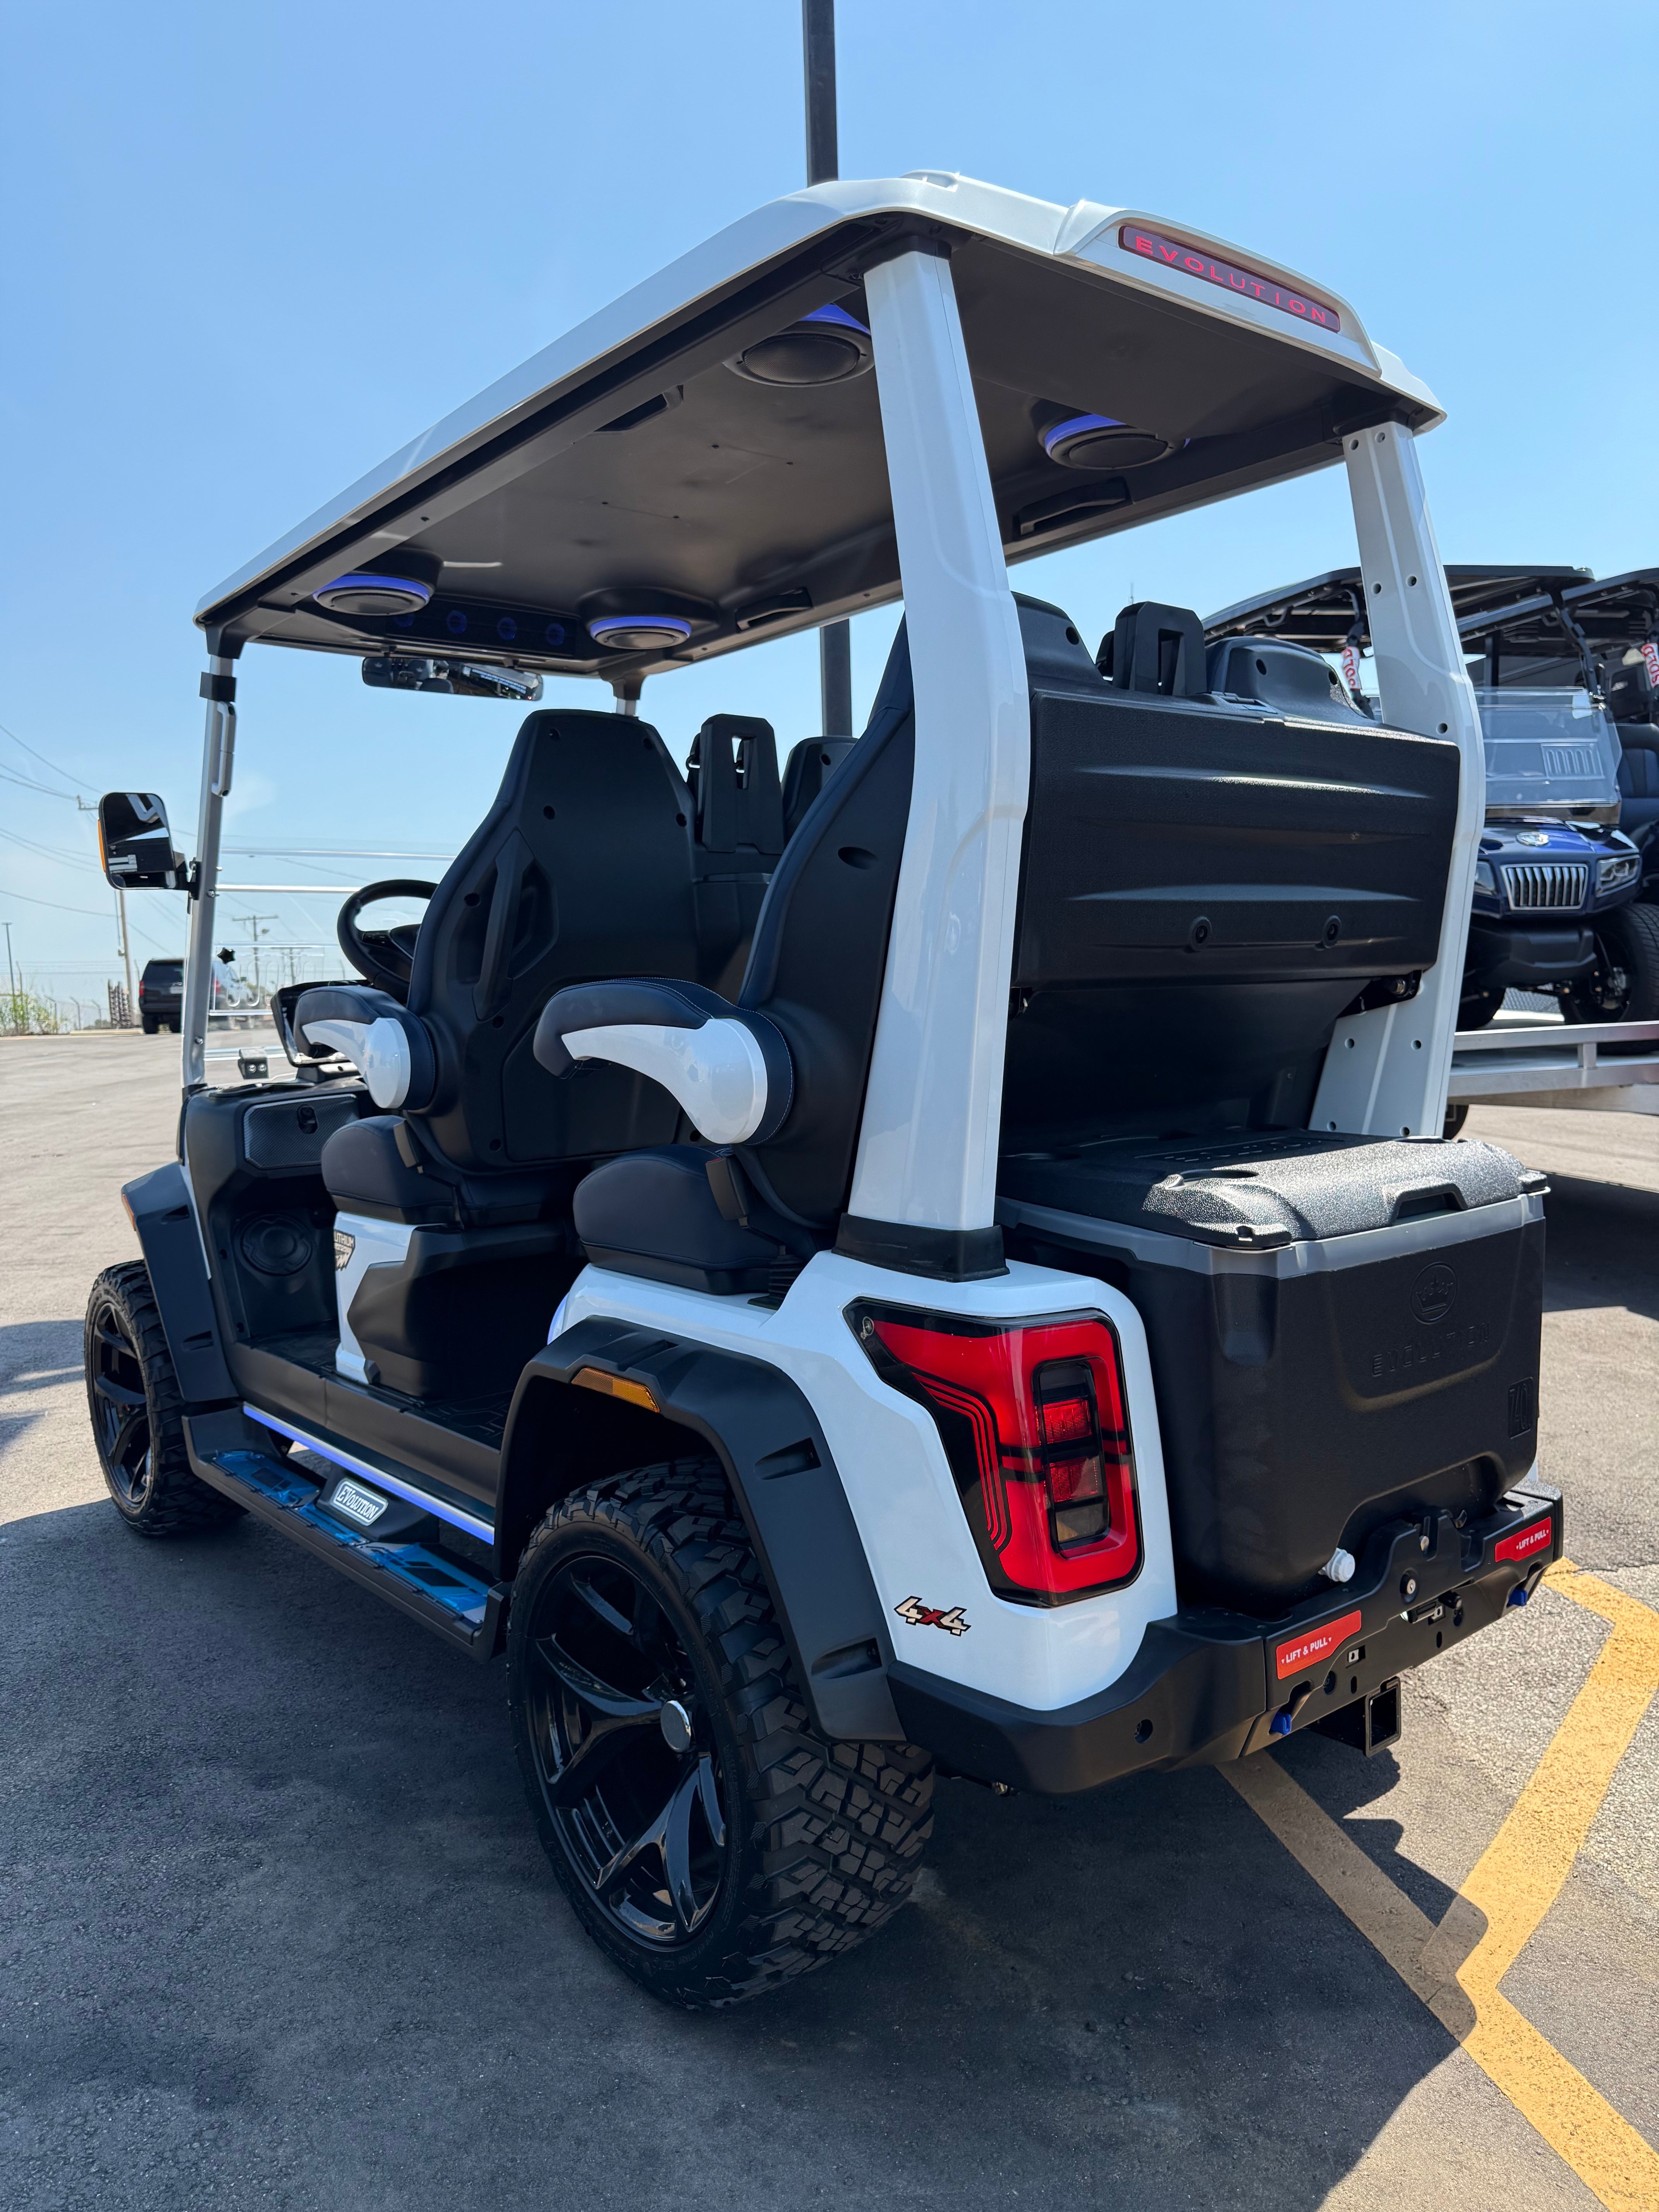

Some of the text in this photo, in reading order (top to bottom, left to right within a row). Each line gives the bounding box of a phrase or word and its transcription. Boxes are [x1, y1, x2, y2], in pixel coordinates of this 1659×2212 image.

[1136, 236, 1326, 324] EVOLUTION
[337, 1486, 379, 1519] EVOLUTION
[1519, 1529, 1546, 1550] LIFT & PULL
[1285, 1637, 1328, 1664] LIFT & PULL
